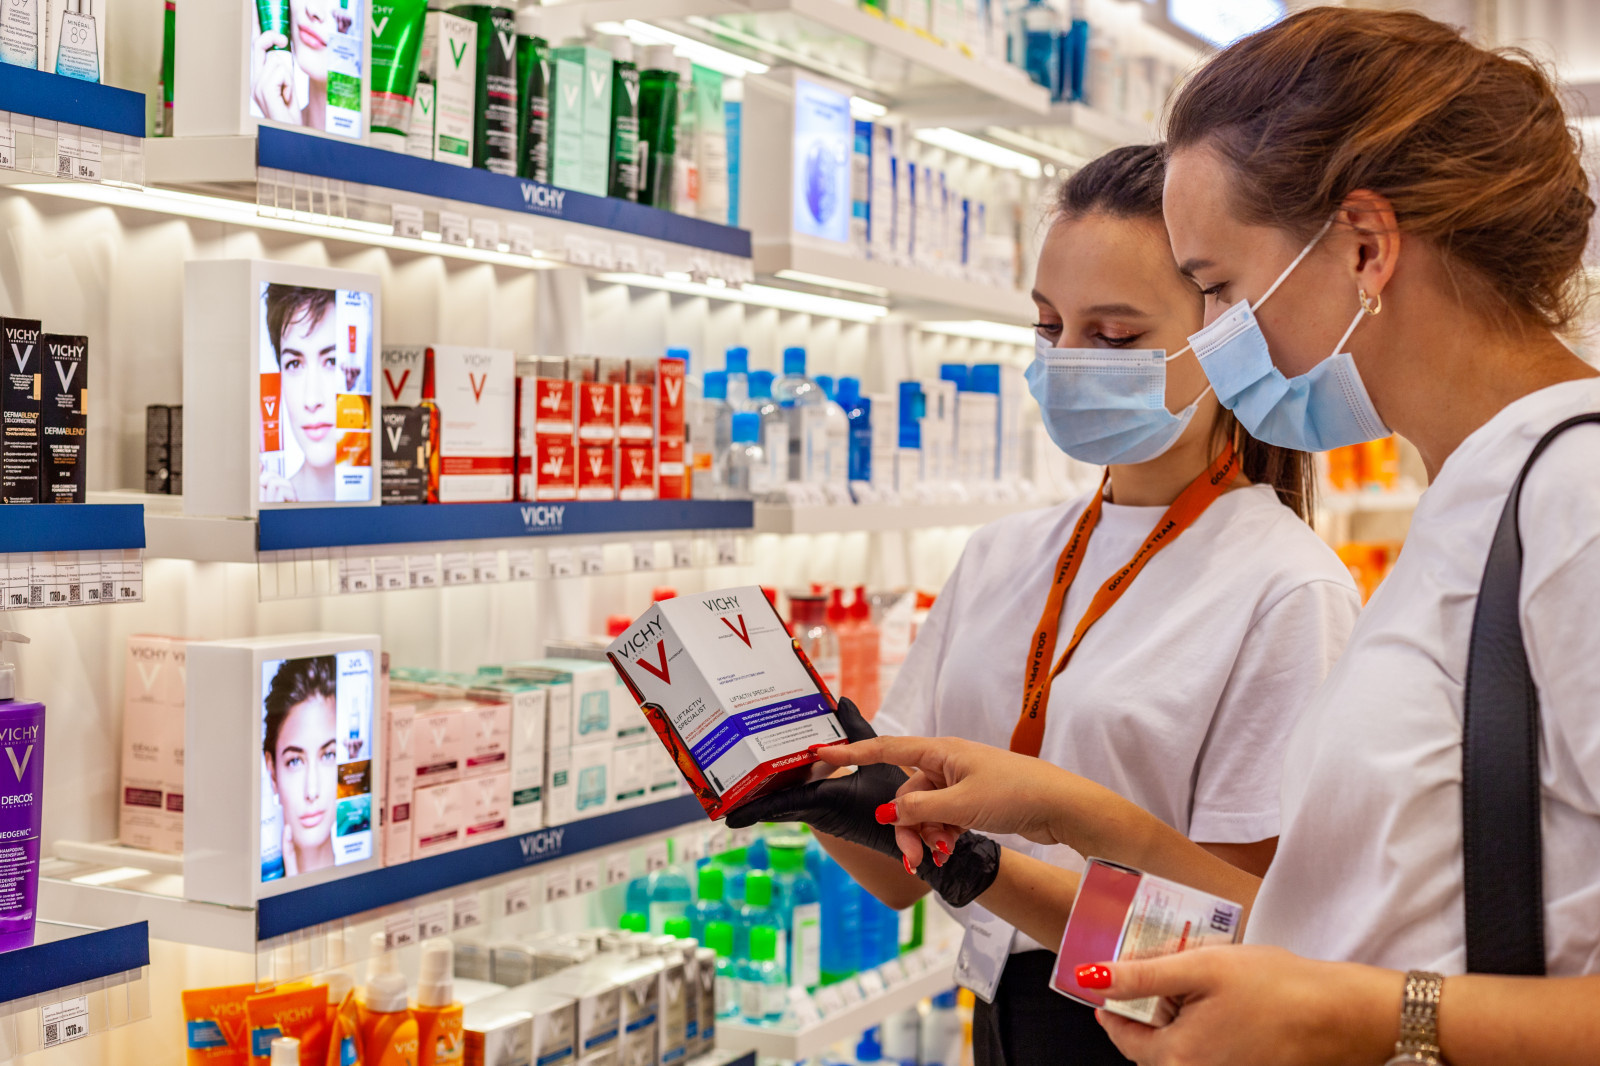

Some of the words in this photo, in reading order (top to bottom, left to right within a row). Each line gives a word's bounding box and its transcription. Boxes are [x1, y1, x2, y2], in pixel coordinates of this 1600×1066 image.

[67, 19, 91, 29] MINÉRAL
[70, 26, 88, 45] 89
[520, 182, 566, 209] VICHY
[5, 327, 40, 341] VICHY
[48, 343, 85, 358] VICHY
[520, 505, 566, 526] VICHY
[1108, 569, 1130, 591] GOLD
[1152, 520, 1177, 543] TEAM
[1056, 561, 1071, 585] TEAM
[702, 595, 740, 612] VICHY
[617, 614, 662, 659] VICHY
[1035, 631, 1047, 658] GOLD
[1028, 660, 1040, 689] APPLE
[729, 690, 753, 703] LIFTACTIV
[673, 697, 702, 725] LIFTACTIV
[677, 704, 707, 731] SPECIALIST
[0, 724, 39, 741] VICHY
[1, 792, 33, 805] DERCOS
[519, 828, 565, 857] VICHY
[273, 1006, 314, 1023] VICHY
